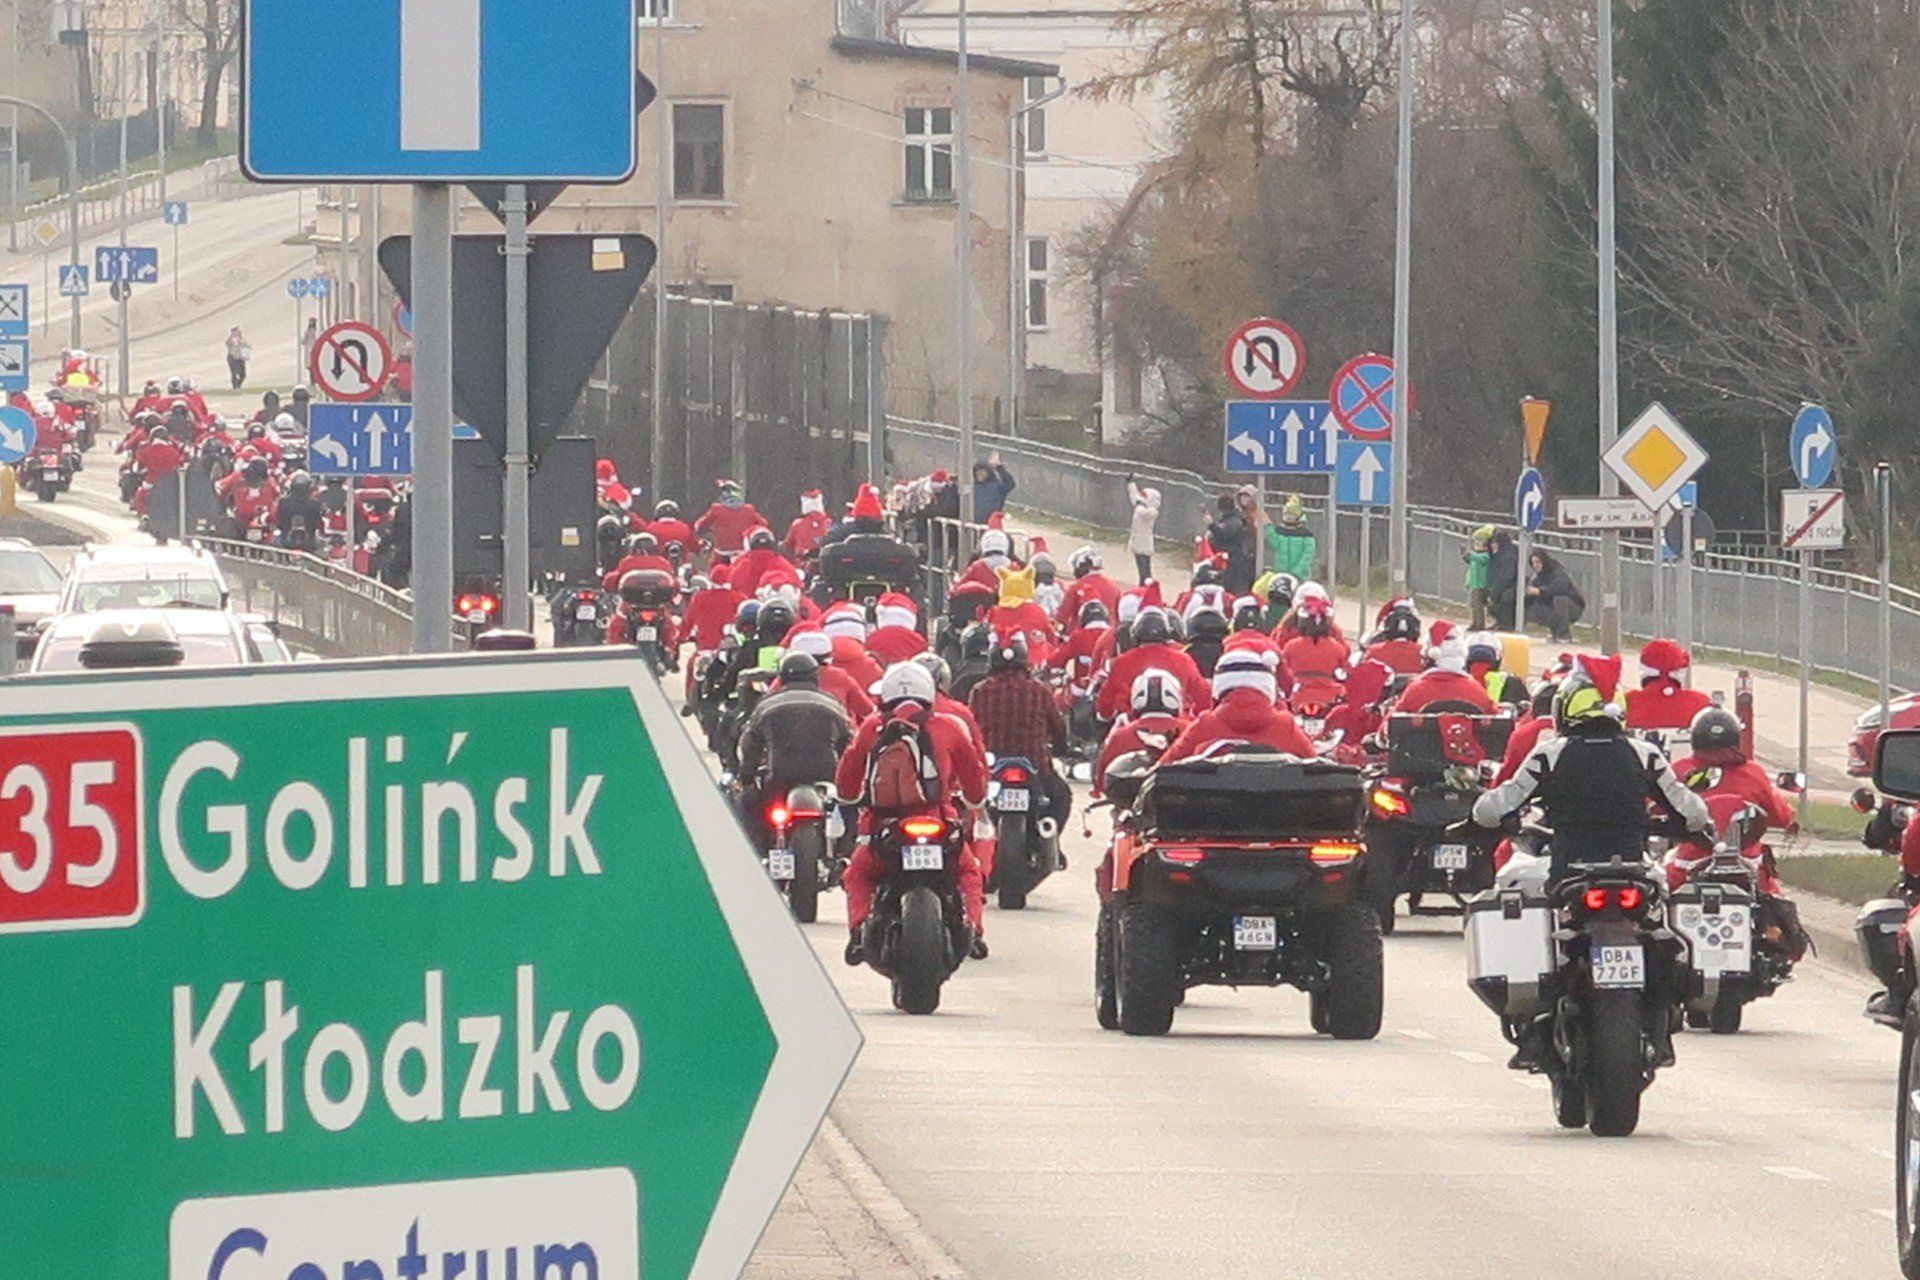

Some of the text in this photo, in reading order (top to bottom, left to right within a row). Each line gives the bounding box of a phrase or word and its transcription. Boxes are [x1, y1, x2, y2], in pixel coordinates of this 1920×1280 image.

[0, 760, 118, 894] 35
[159, 727, 605, 899] Golińsk
[1596, 965, 1641, 981] 77GF
[1603, 949, 1634, 963] DBA
[171, 964, 641, 1139] Kłodzko
